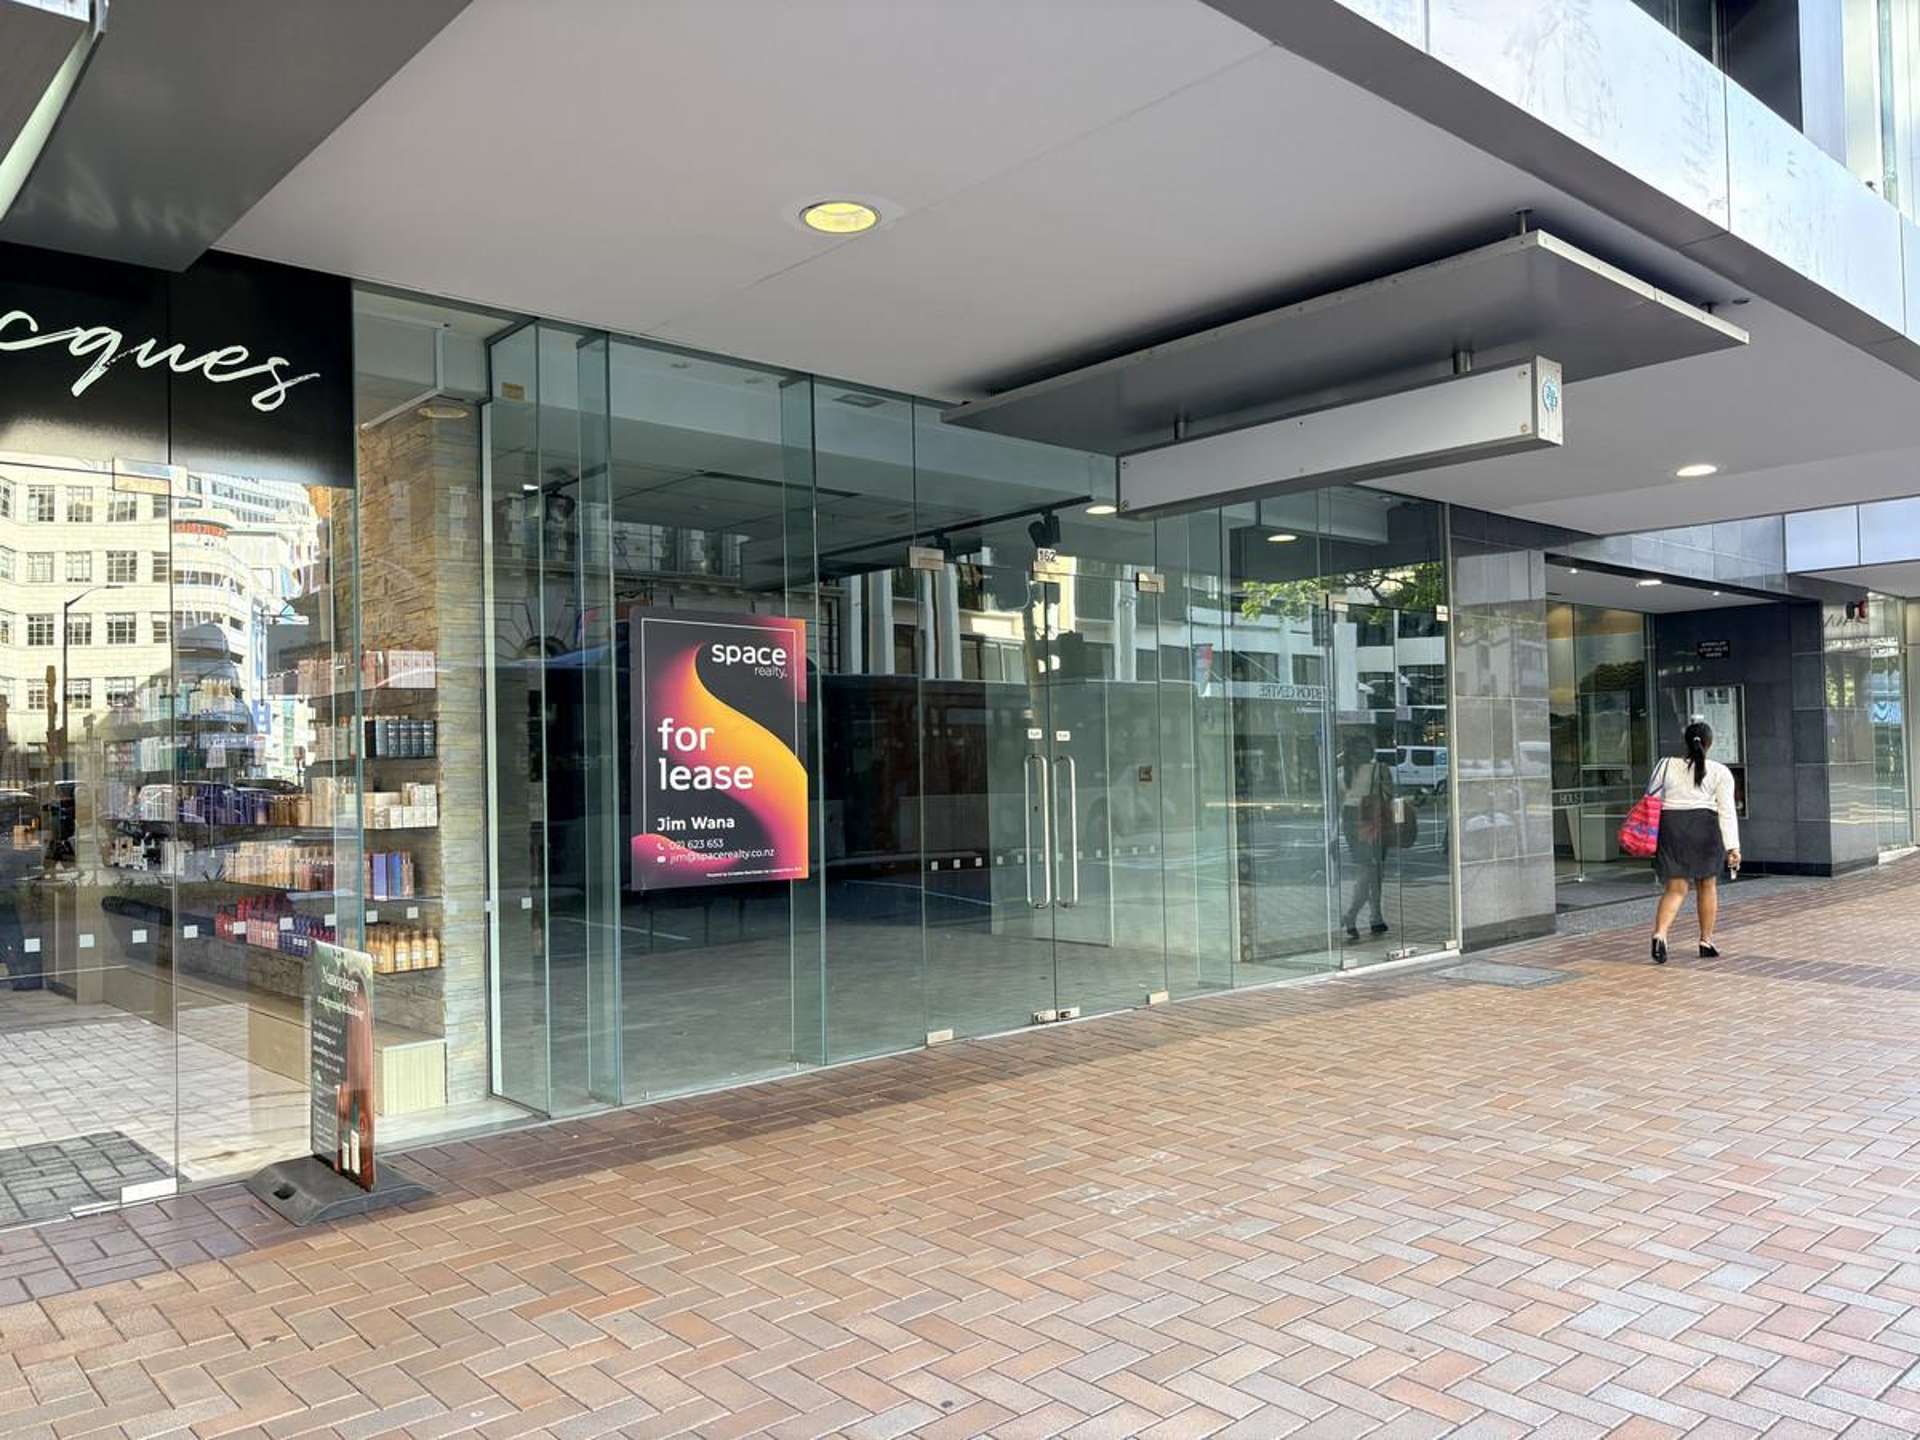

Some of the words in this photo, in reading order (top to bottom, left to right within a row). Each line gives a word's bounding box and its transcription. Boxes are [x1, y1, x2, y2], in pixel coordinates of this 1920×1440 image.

[711, 644, 787, 666] space
[657, 718, 714, 752] for
[658, 757, 754, 791] lease
[657, 816, 686, 831] Jim
[691, 816, 735, 830] Wana
[687, 839, 705, 849] 623
[706, 838, 724, 848] 653
